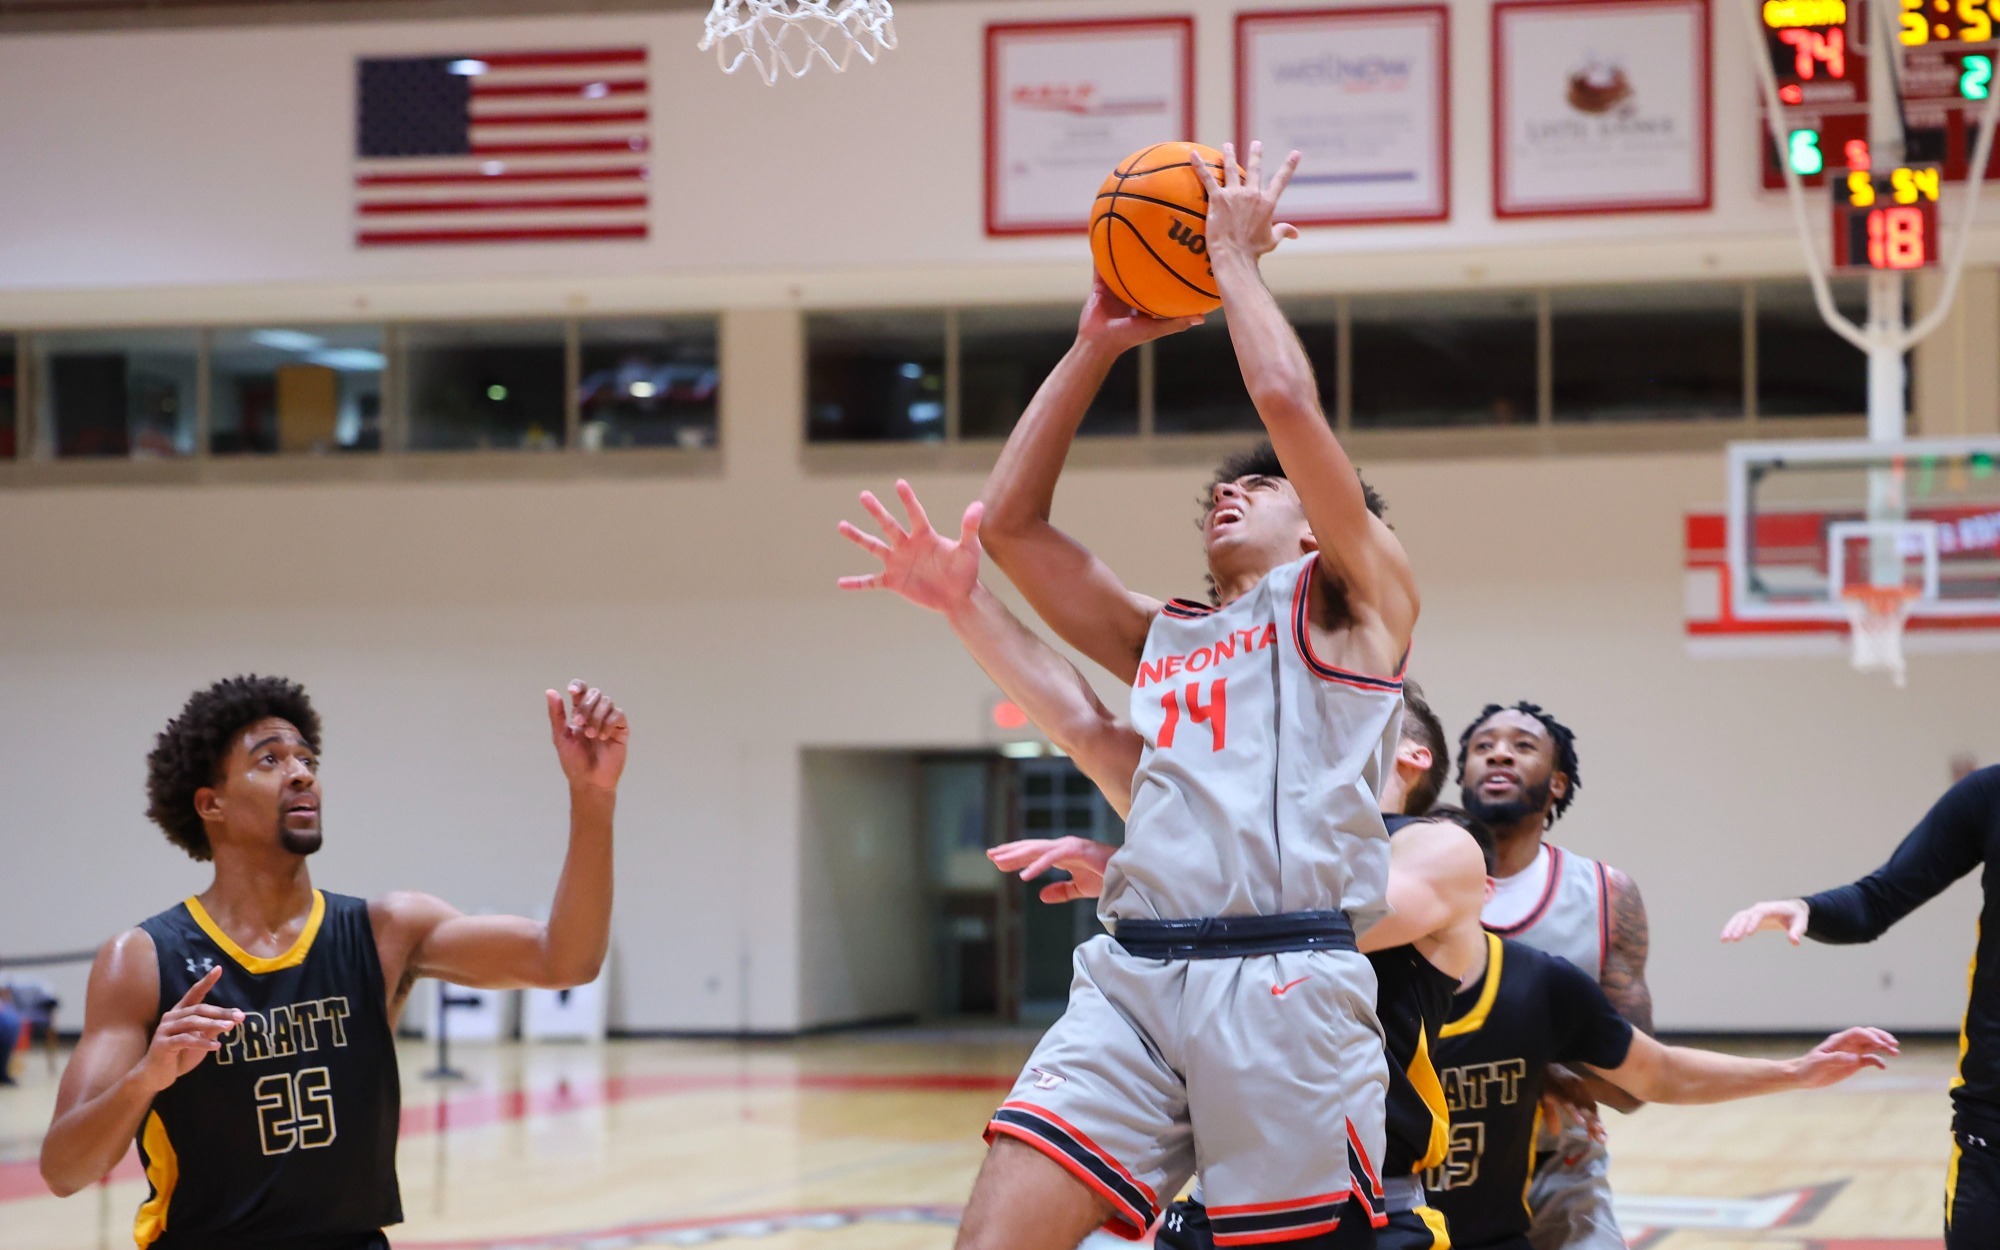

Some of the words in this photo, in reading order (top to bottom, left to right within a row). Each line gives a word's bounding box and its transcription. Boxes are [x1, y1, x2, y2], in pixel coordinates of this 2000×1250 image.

[1898, 0, 2000, 46] 5:5
[1778, 27, 1845, 80] 74
[1960, 55, 1992, 100] 2
[1789, 129, 1823, 175] 6
[1867, 207, 1925, 270] 18
[1137, 622, 1278, 688] NEONTA
[1157, 677, 1228, 753] 14
[215, 996, 351, 1065] PRATT
[254, 1066, 338, 1156] 25
[1441, 1058, 1526, 1111] ATT
